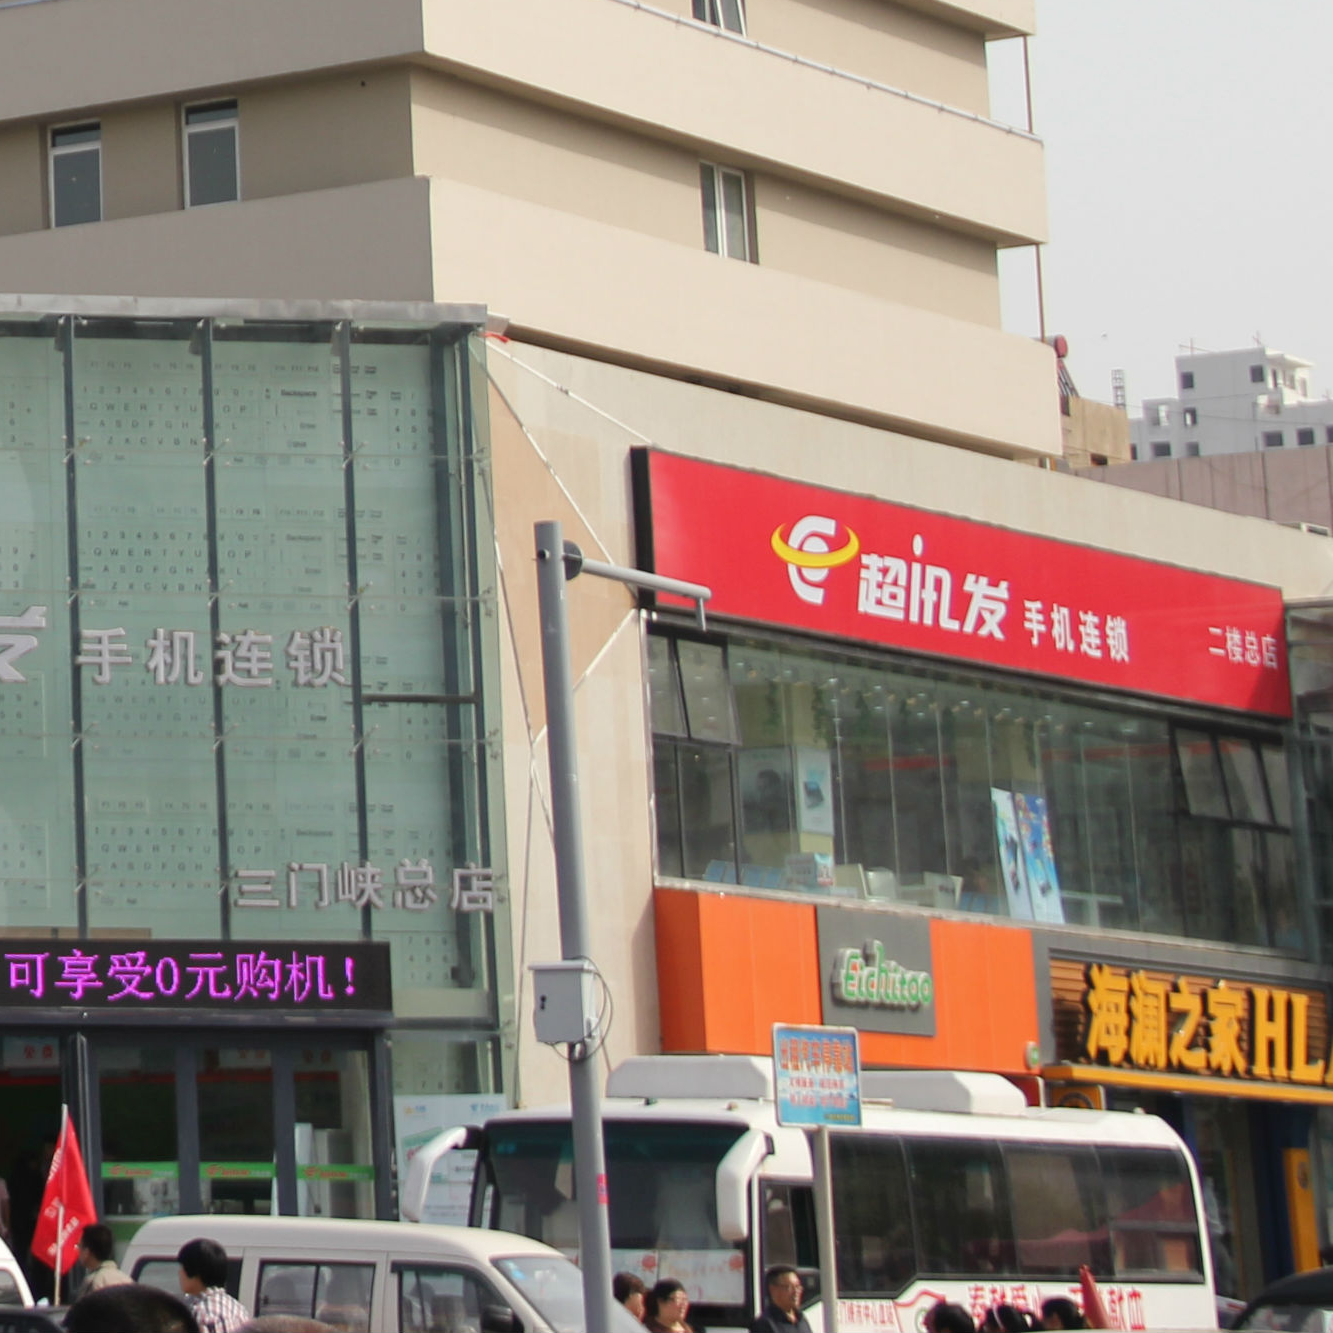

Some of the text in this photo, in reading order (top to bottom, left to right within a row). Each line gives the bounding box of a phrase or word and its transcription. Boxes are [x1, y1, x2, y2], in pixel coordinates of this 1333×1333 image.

[857, 533, 1130, 663] 超讯发 手机连锁
[74, 626, 351, 688] 手机连锁
[1207, 626, 1279, 670] 二楼总店
[234, 857, 494, 913] 三门峡总店
[839, 940, 933, 1006] Eichitoo
[1086, 963, 1333, 1083] 海澜之家 HL
